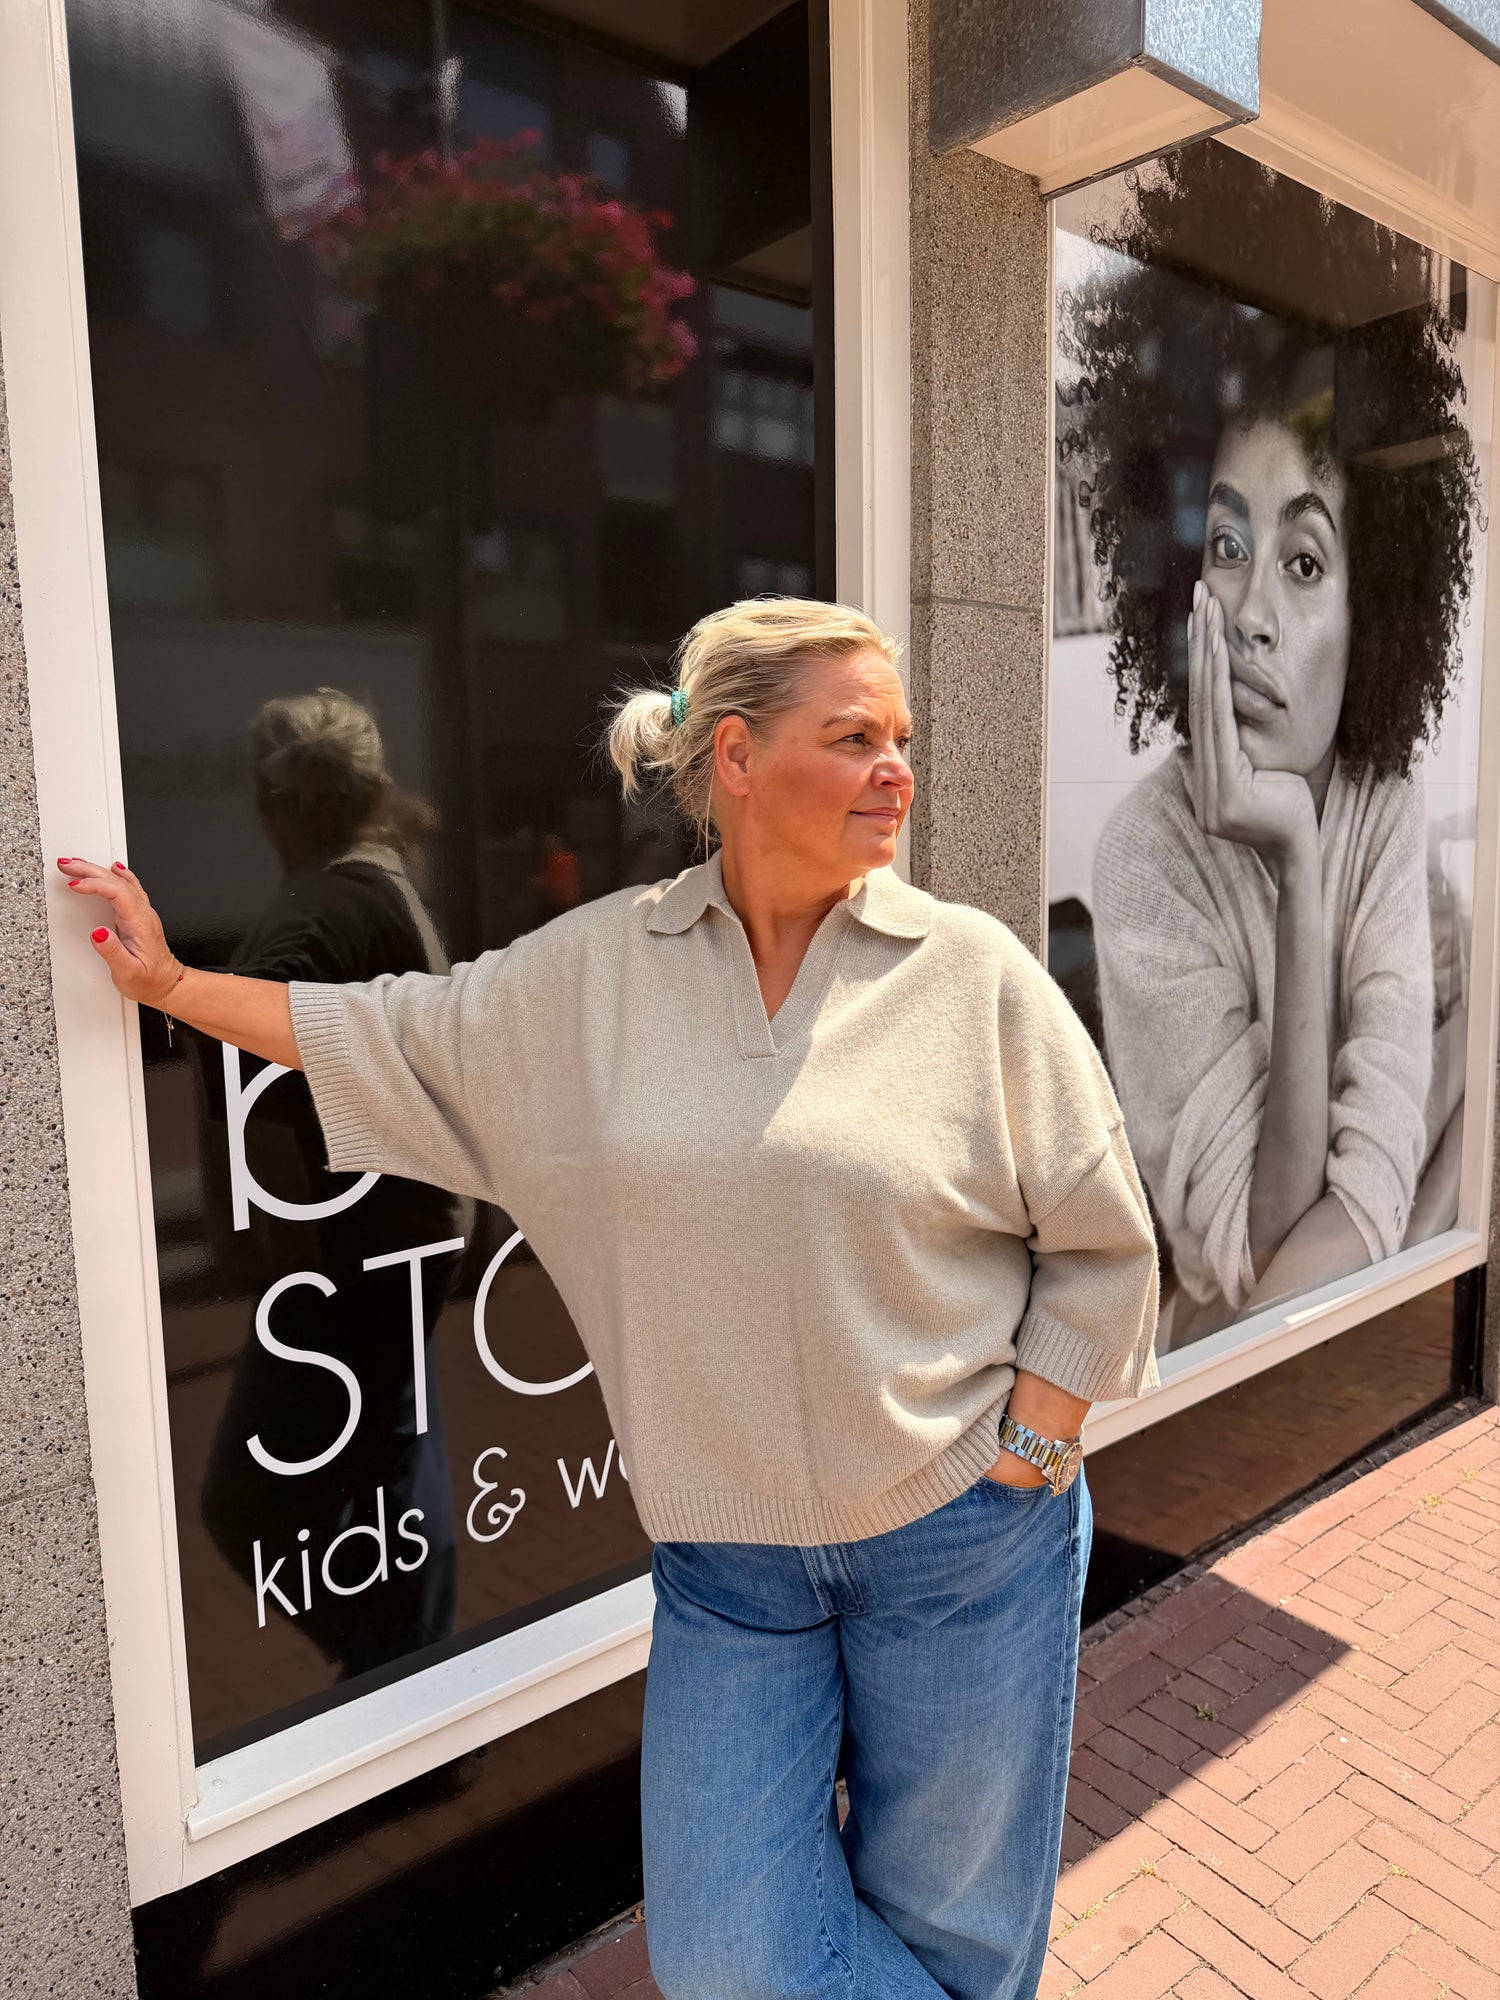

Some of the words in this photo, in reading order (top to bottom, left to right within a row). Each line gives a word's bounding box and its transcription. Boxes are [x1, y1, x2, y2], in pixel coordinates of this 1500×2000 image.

[253, 1487, 429, 1627] kids
[466, 1446, 526, 1542] &
[557, 1439, 629, 1509] w
